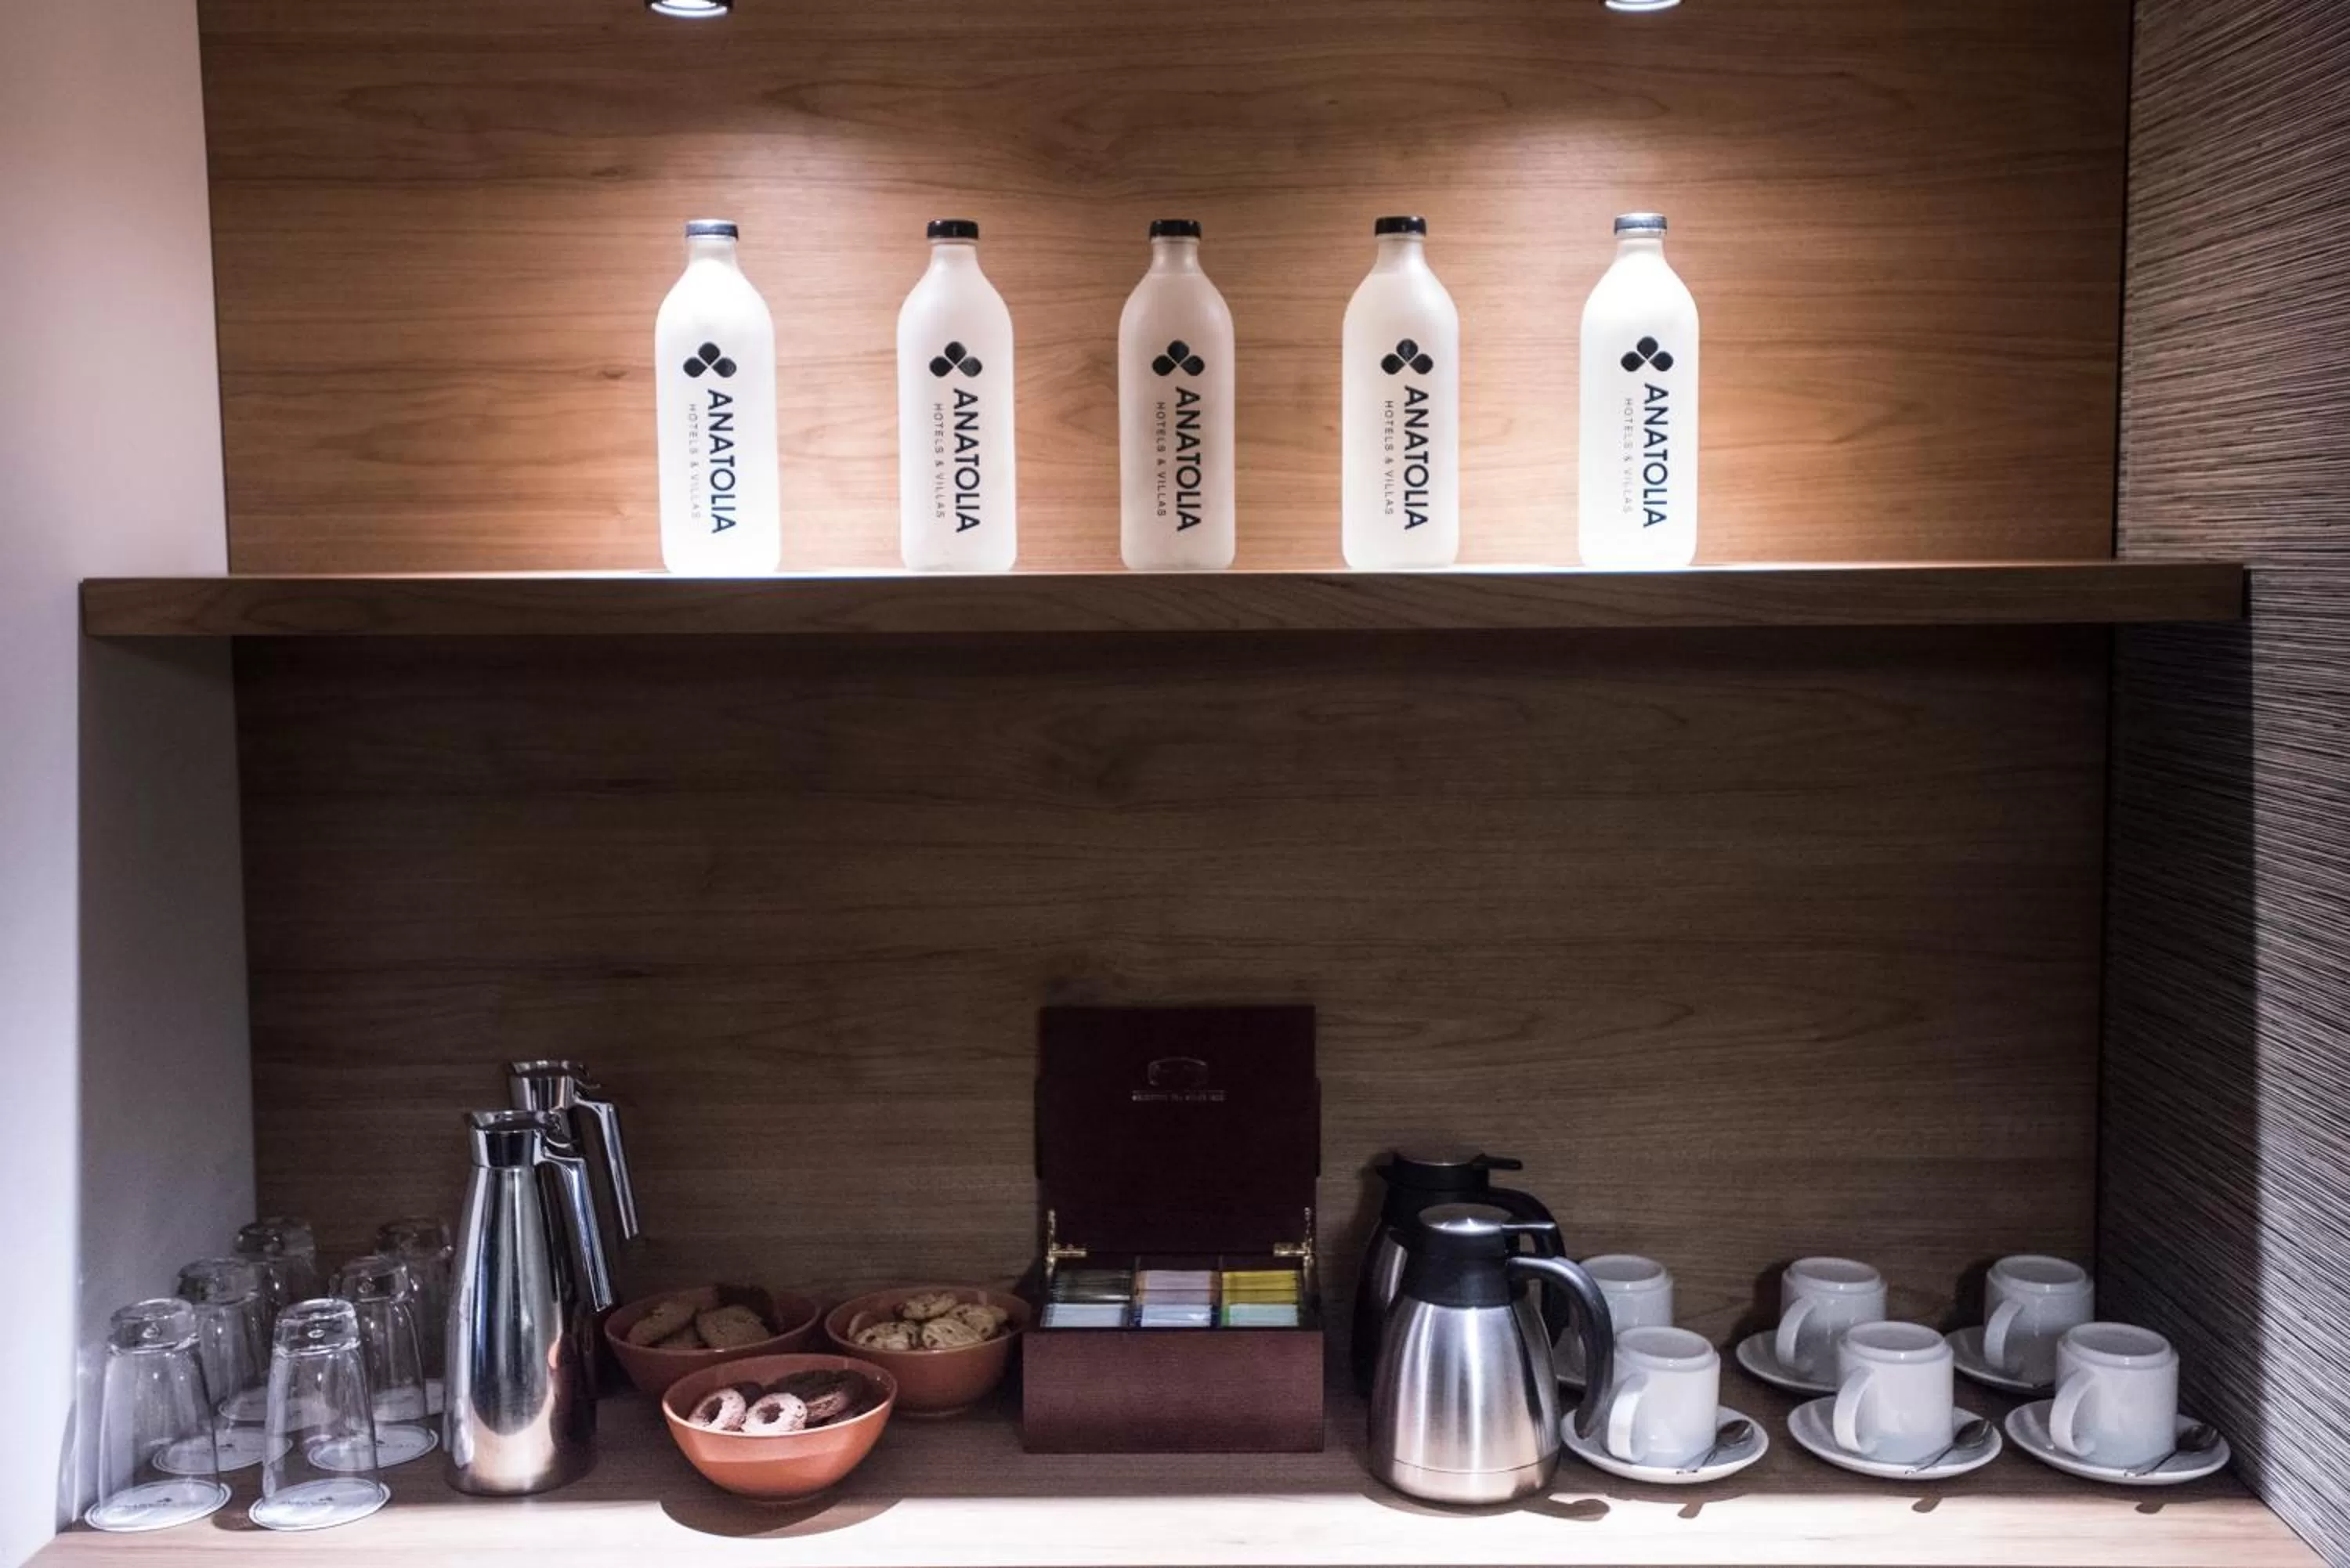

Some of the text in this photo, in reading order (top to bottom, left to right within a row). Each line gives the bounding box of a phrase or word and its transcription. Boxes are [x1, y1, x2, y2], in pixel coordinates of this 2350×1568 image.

[689, 403, 698, 454] HOTELS
[933, 403, 944, 453] HOTELS
[1156, 402, 1166, 452] HOTELS
[1385, 400, 1394, 451] HOTELS
[1624, 398, 1633, 449] HOTELS
[707, 388, 736, 533] ANATOLIA
[953, 388, 980, 533] ANATOLIA
[1176, 386, 1202, 532] ANATOLIA
[1404, 385, 1429, 529] ANATOLIA
[1643, 383, 1668, 528] ANATOLIA
[690, 475, 700, 518] VILLAS
[935, 473, 945, 518] VILLAS
[1157, 471, 1166, 517] VILLAS
[1385, 470, 1394, 515] VILLAS
[1623, 468, 1632, 514] VILLAS
